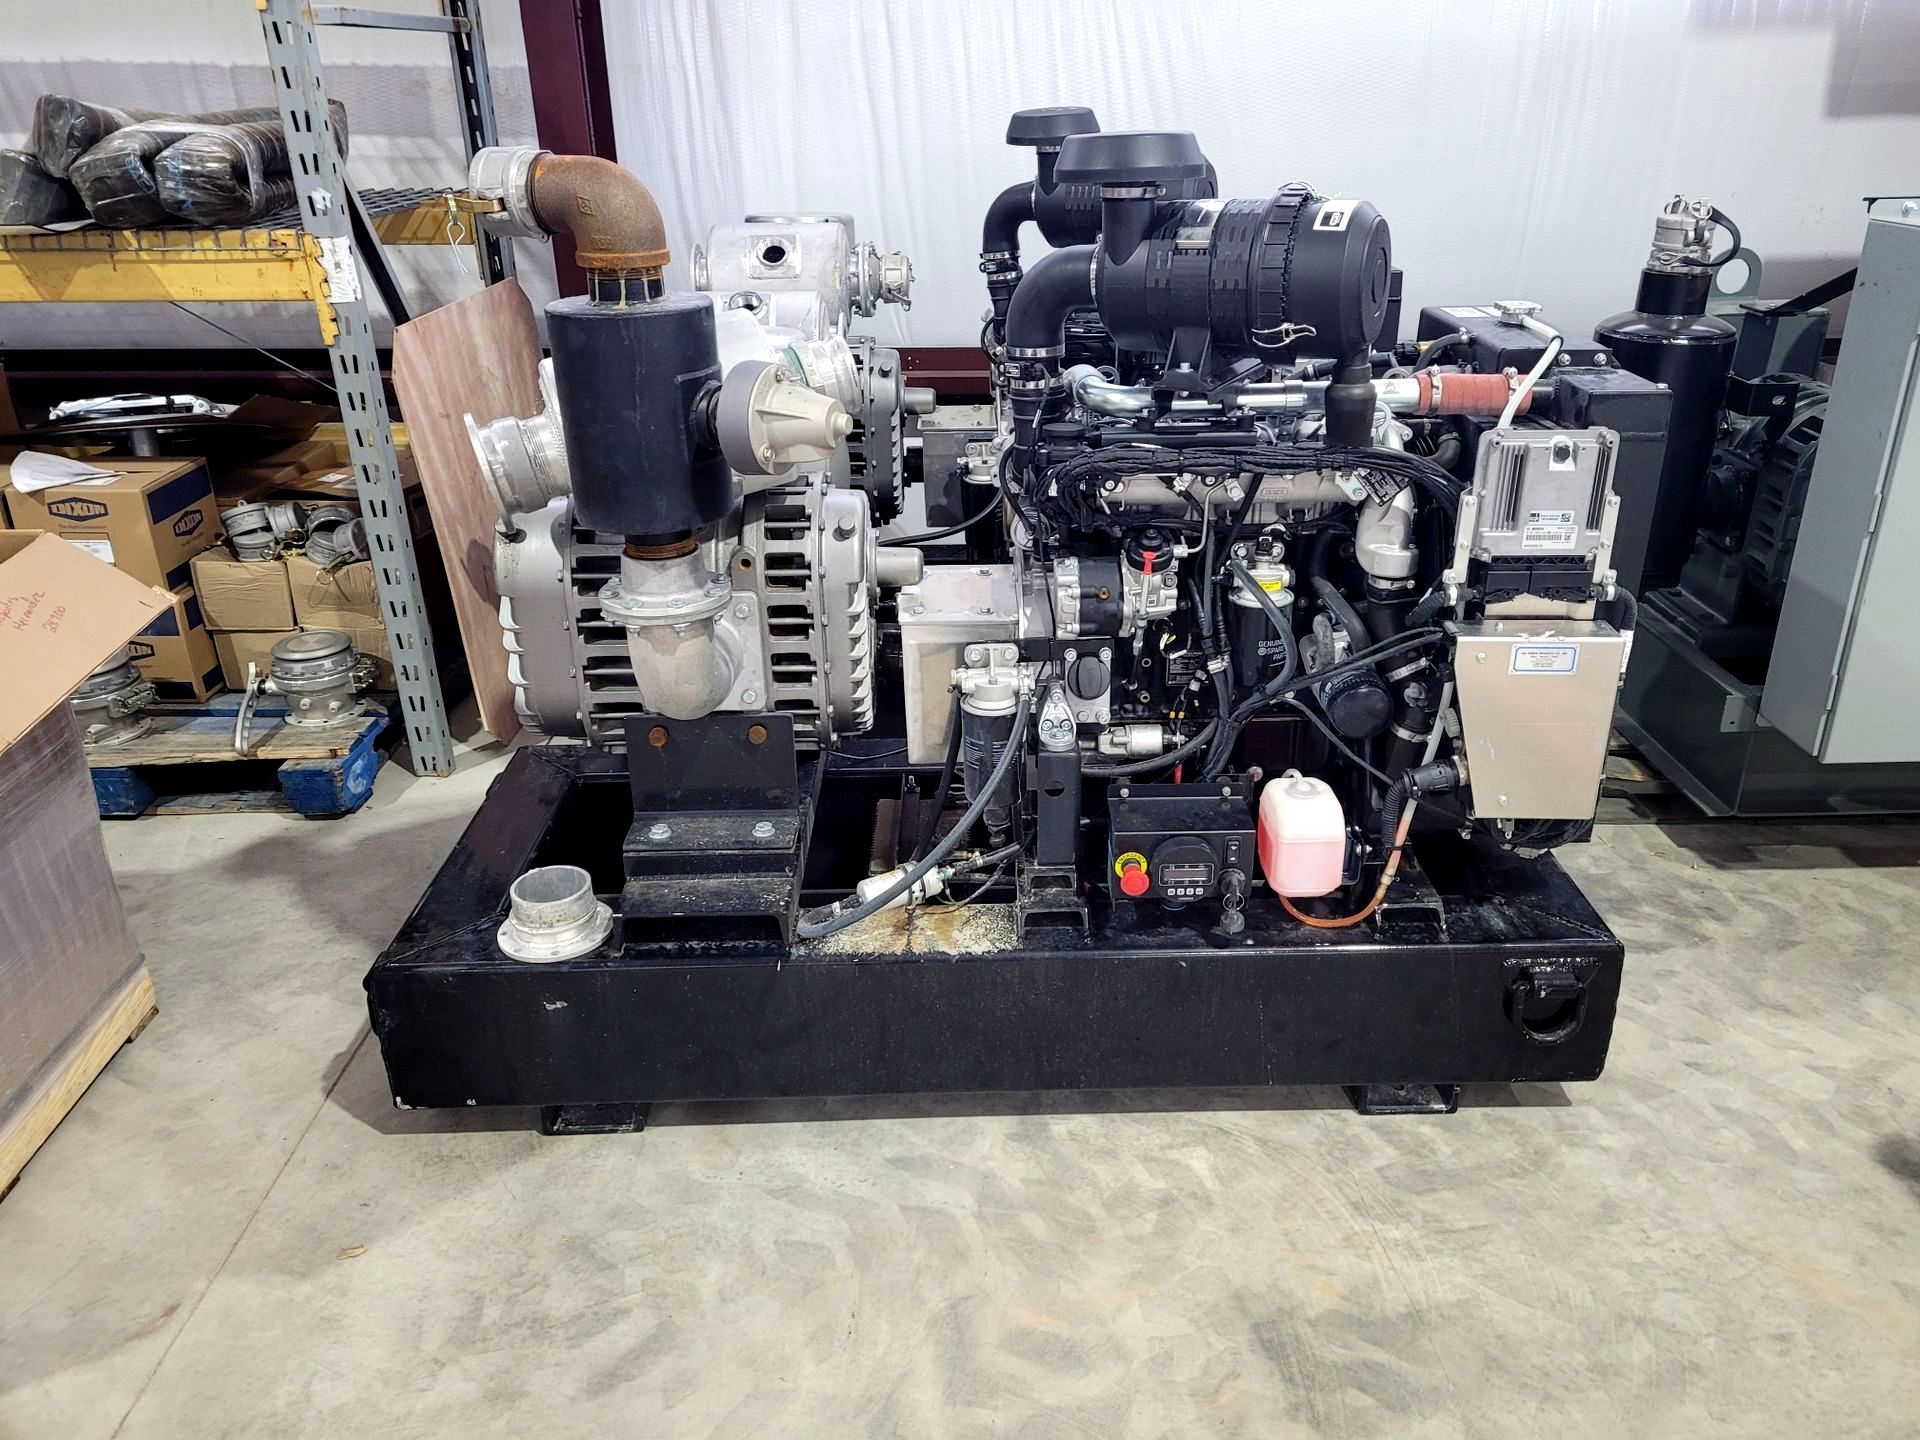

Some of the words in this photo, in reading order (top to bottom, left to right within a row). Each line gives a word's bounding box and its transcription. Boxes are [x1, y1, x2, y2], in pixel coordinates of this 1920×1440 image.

[51, 501, 105, 516] DIXON
[174, 512, 202, 534] DIXON
[1117, 852, 1146, 865] EMERGENCY
